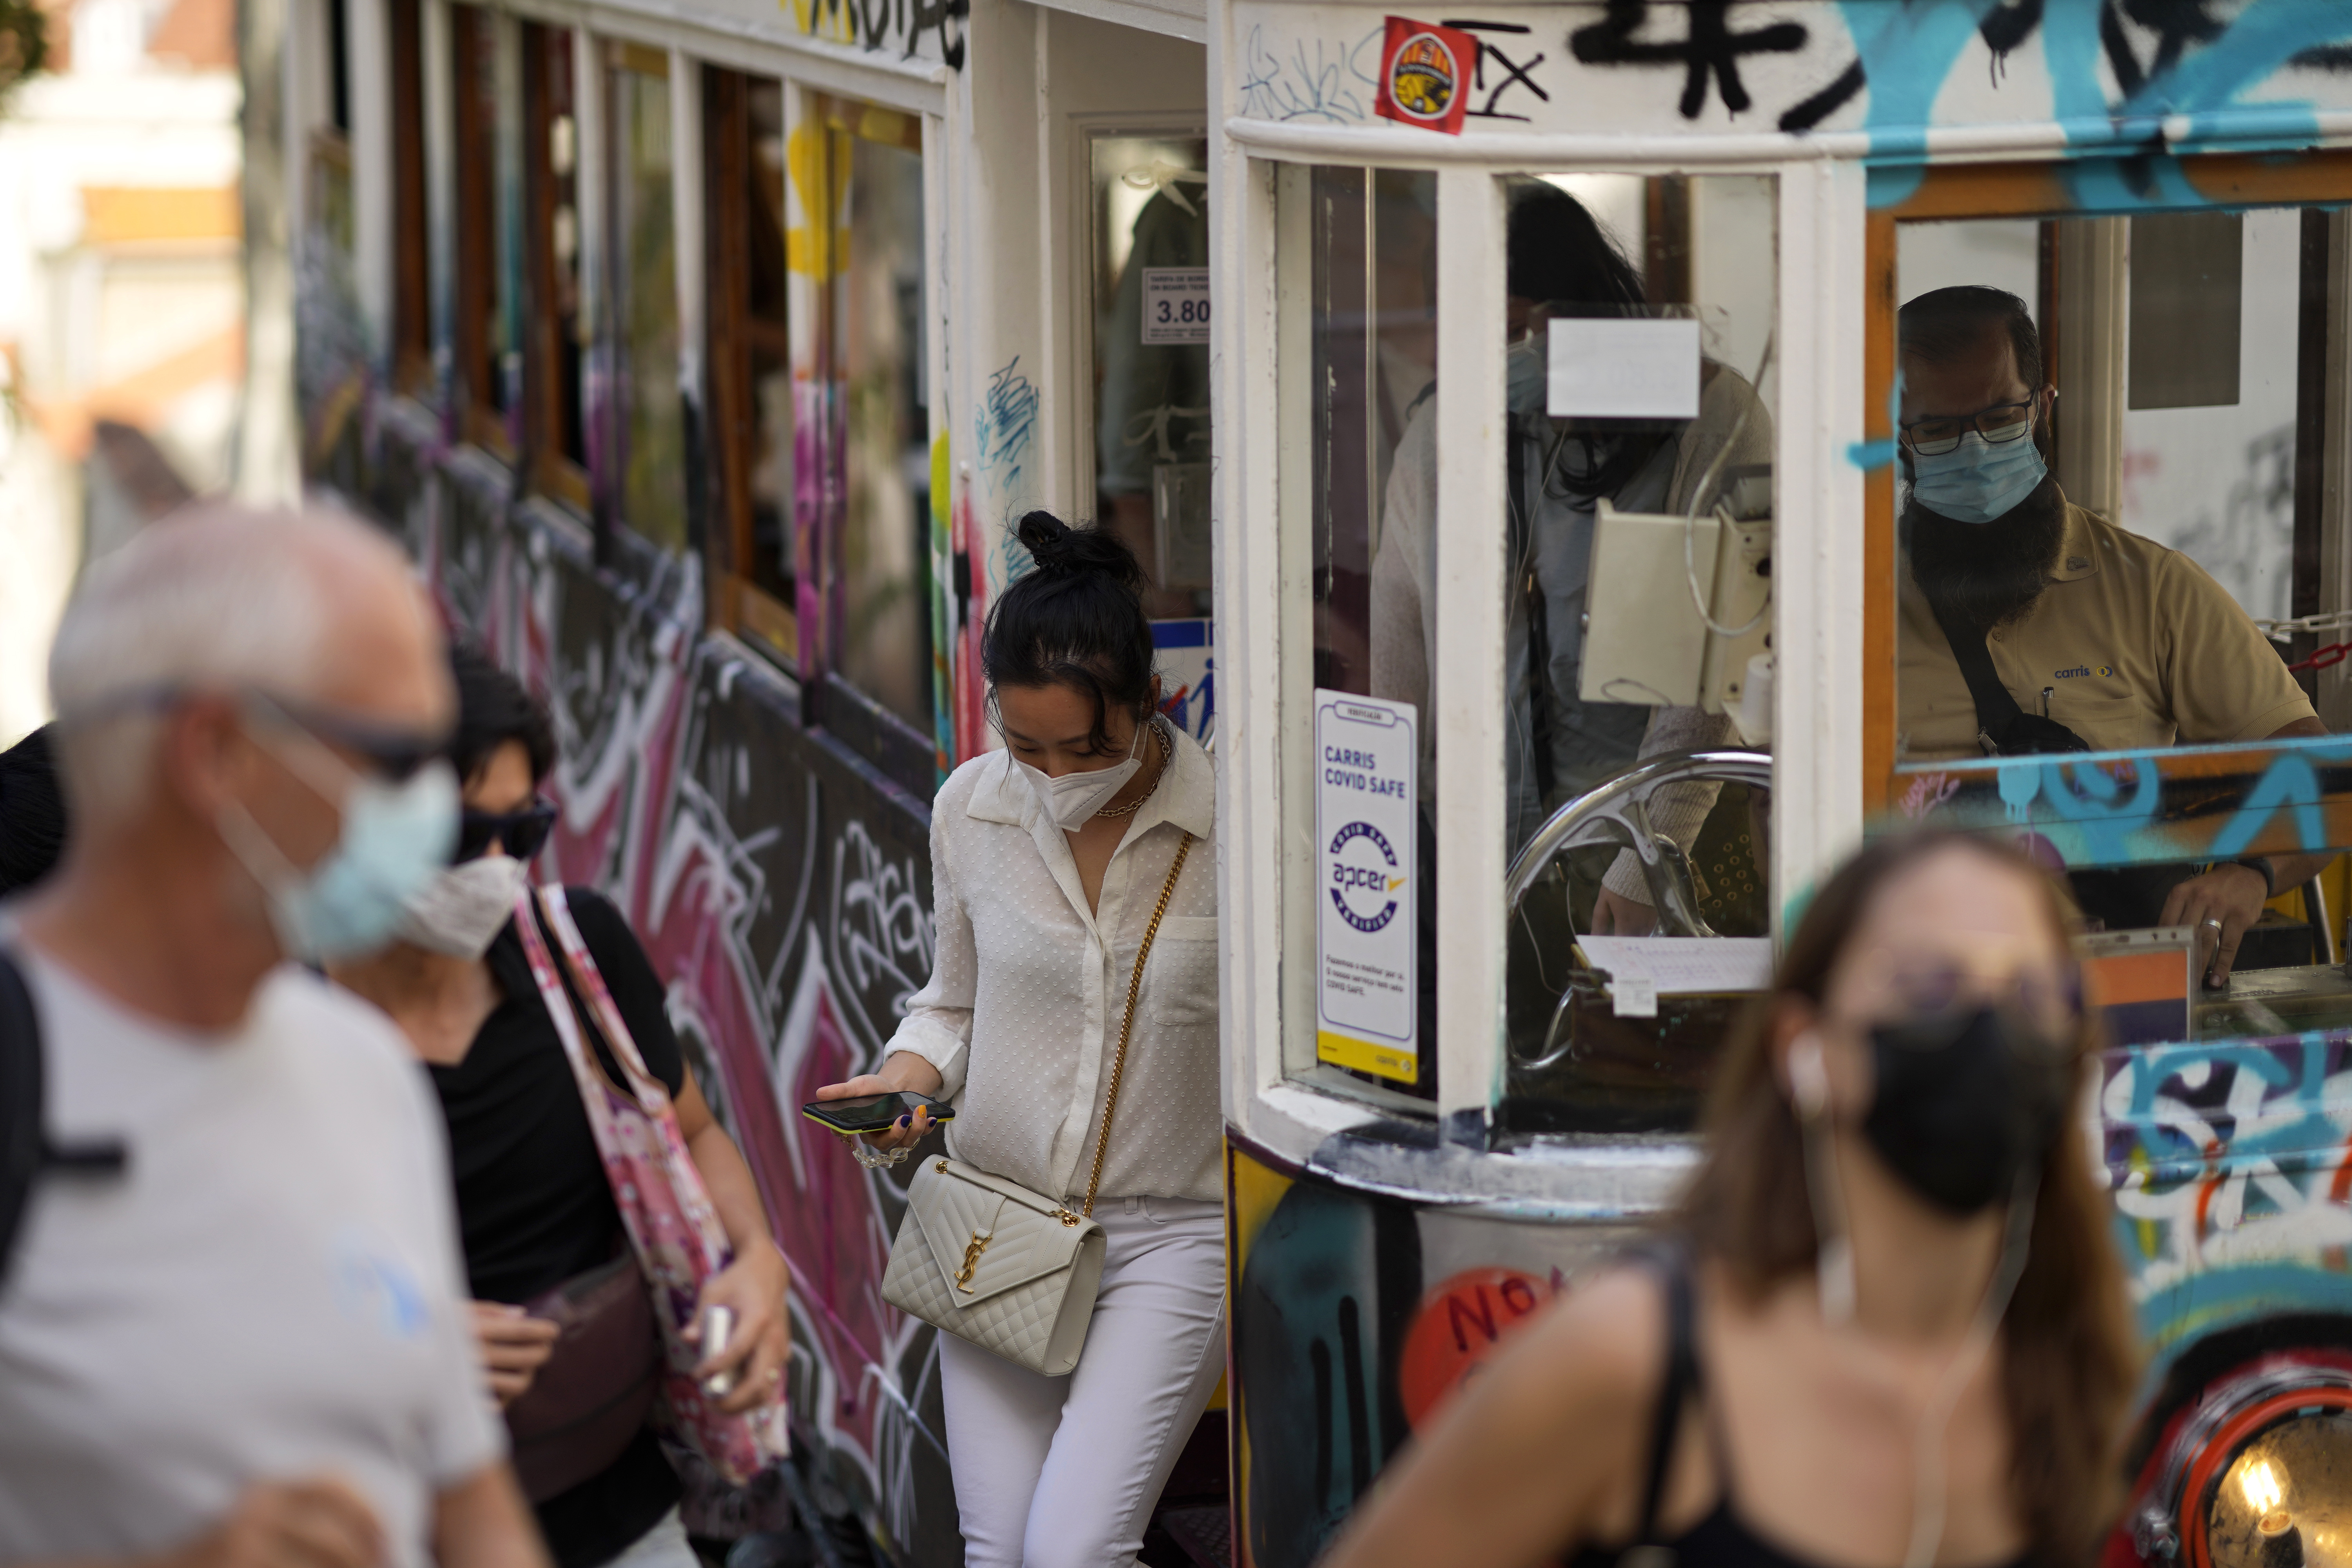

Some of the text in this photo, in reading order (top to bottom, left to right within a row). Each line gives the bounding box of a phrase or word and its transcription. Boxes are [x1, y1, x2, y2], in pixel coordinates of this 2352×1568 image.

[1158, 300, 1210, 323] 3.80
[2054, 665, 2090, 679] carris
[1325, 746, 1375, 769] CARRIS
[1325, 768, 1406, 799] COVID SAFE
[1332, 823, 1395, 864] COVID SAFE
[1333, 862, 1387, 892] apcer
[1337, 898, 1393, 932] VERIFIED
